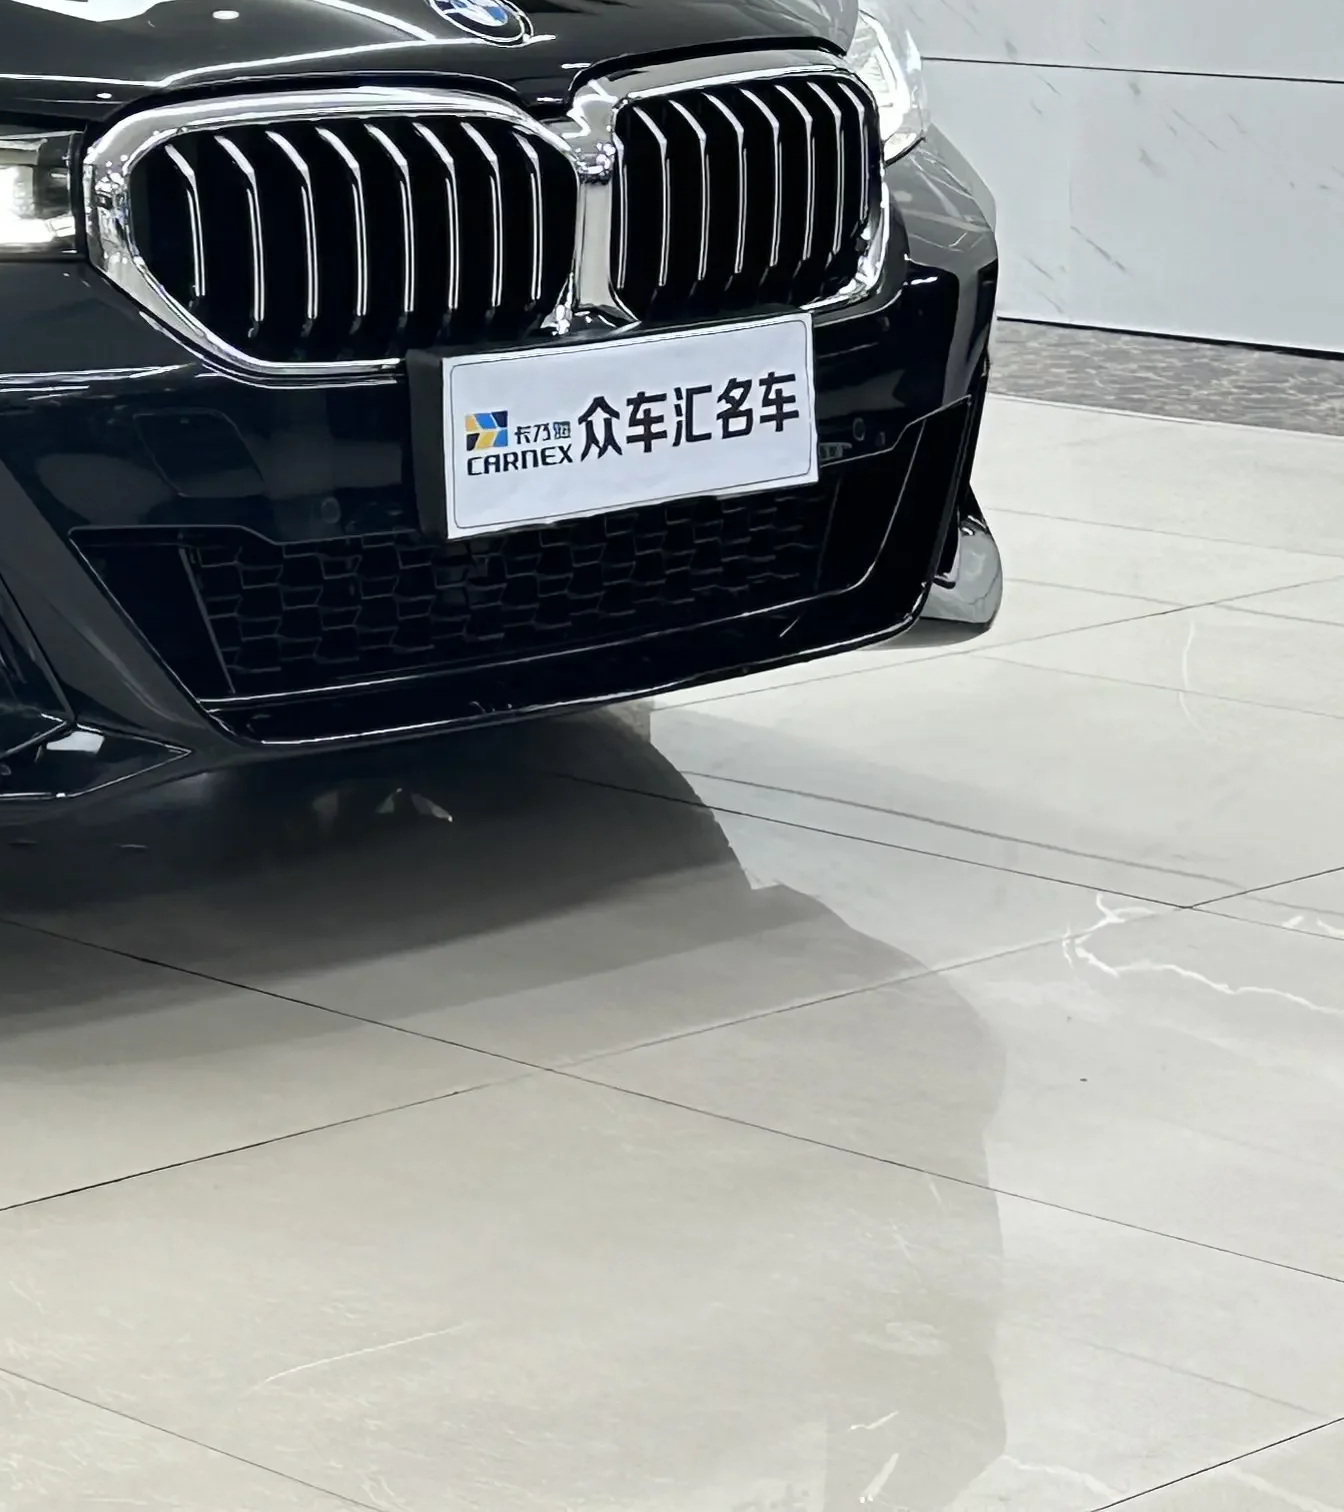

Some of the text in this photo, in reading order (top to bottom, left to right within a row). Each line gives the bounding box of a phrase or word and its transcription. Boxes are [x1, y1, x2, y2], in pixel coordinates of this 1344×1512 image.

[577, 371, 800, 461] 众车汇名车
[467, 443, 573, 476] CARNEX
